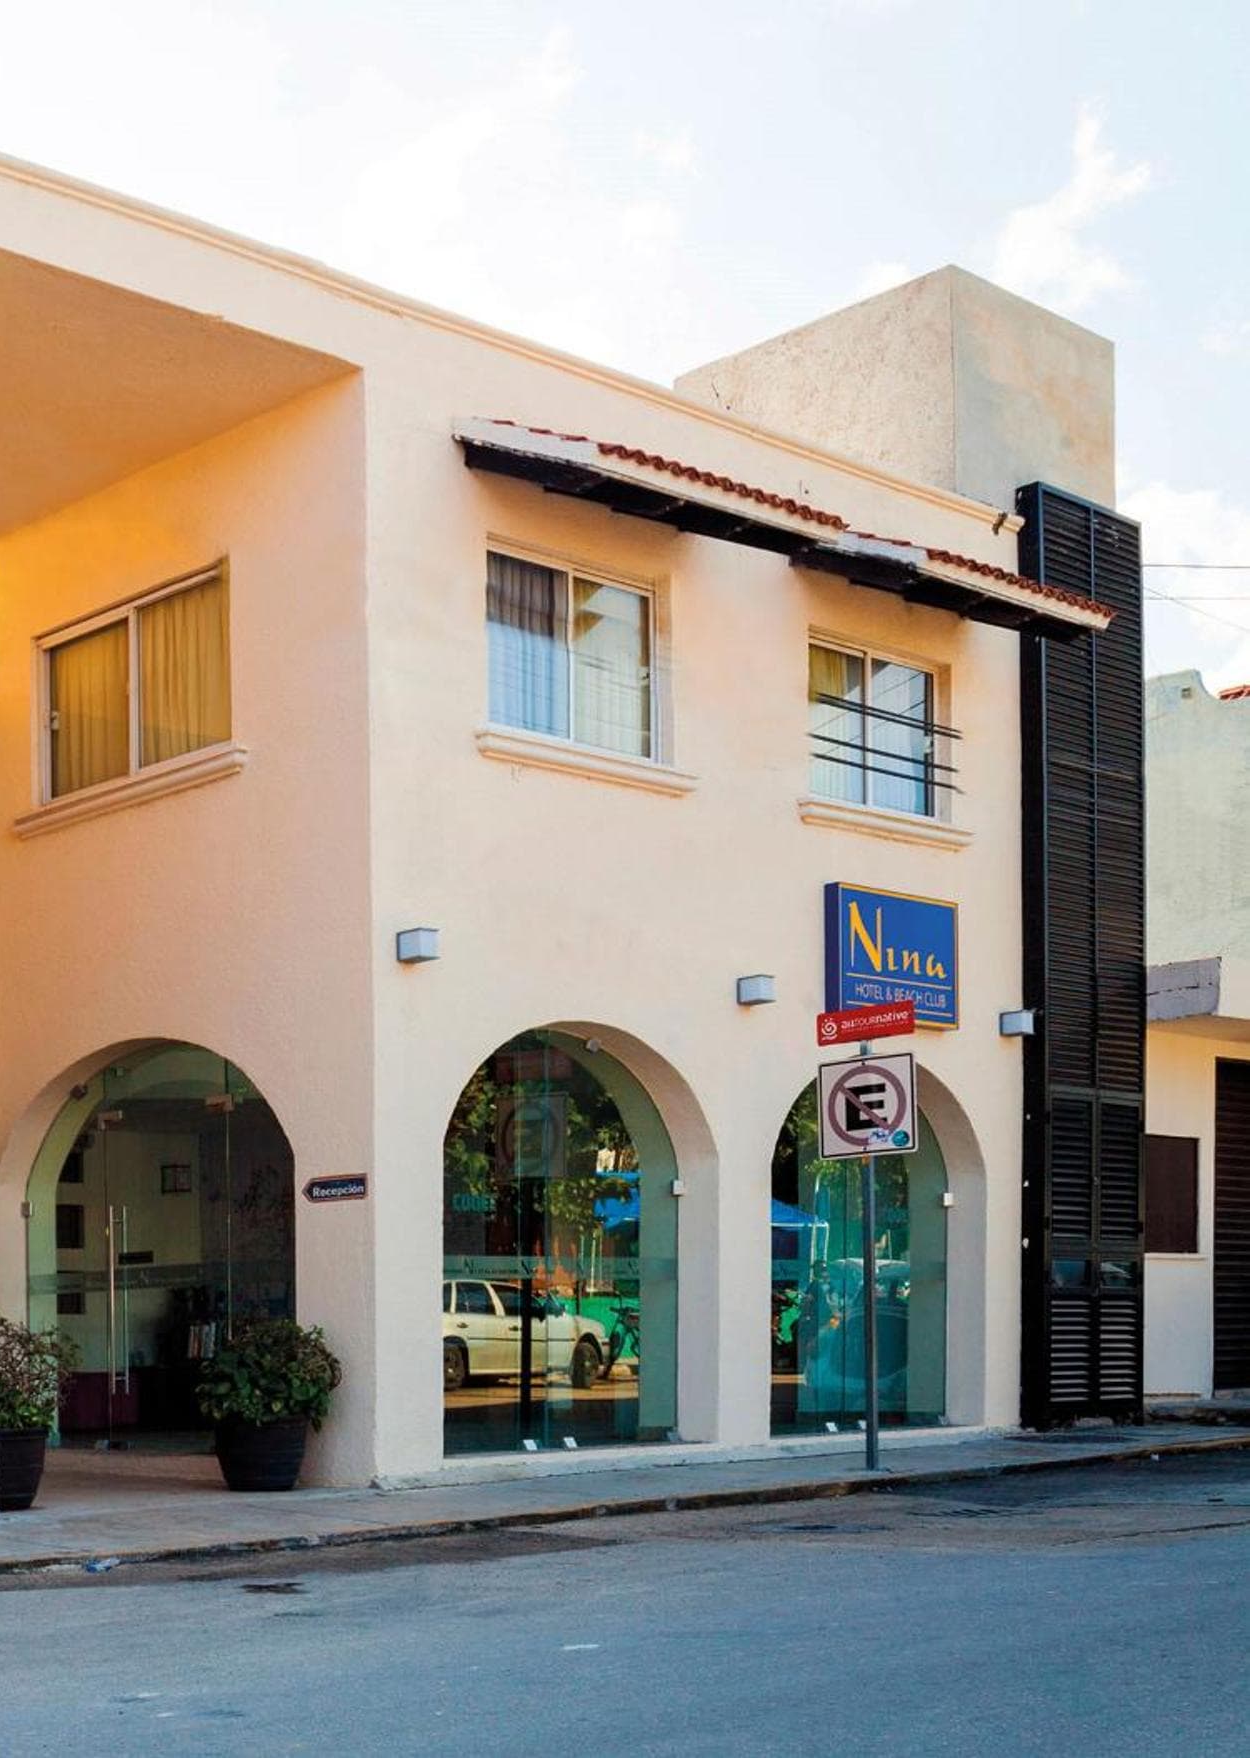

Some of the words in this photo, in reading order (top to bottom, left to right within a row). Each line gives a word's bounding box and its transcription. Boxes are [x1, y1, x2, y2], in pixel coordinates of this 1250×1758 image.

[849, 901, 946, 978] Nina
[854, 983, 884, 1000] HOTEL
[885, 986, 892, 1001] &
[894, 987, 922, 1005] BEACH
[924, 991, 946, 1008] CLUB
